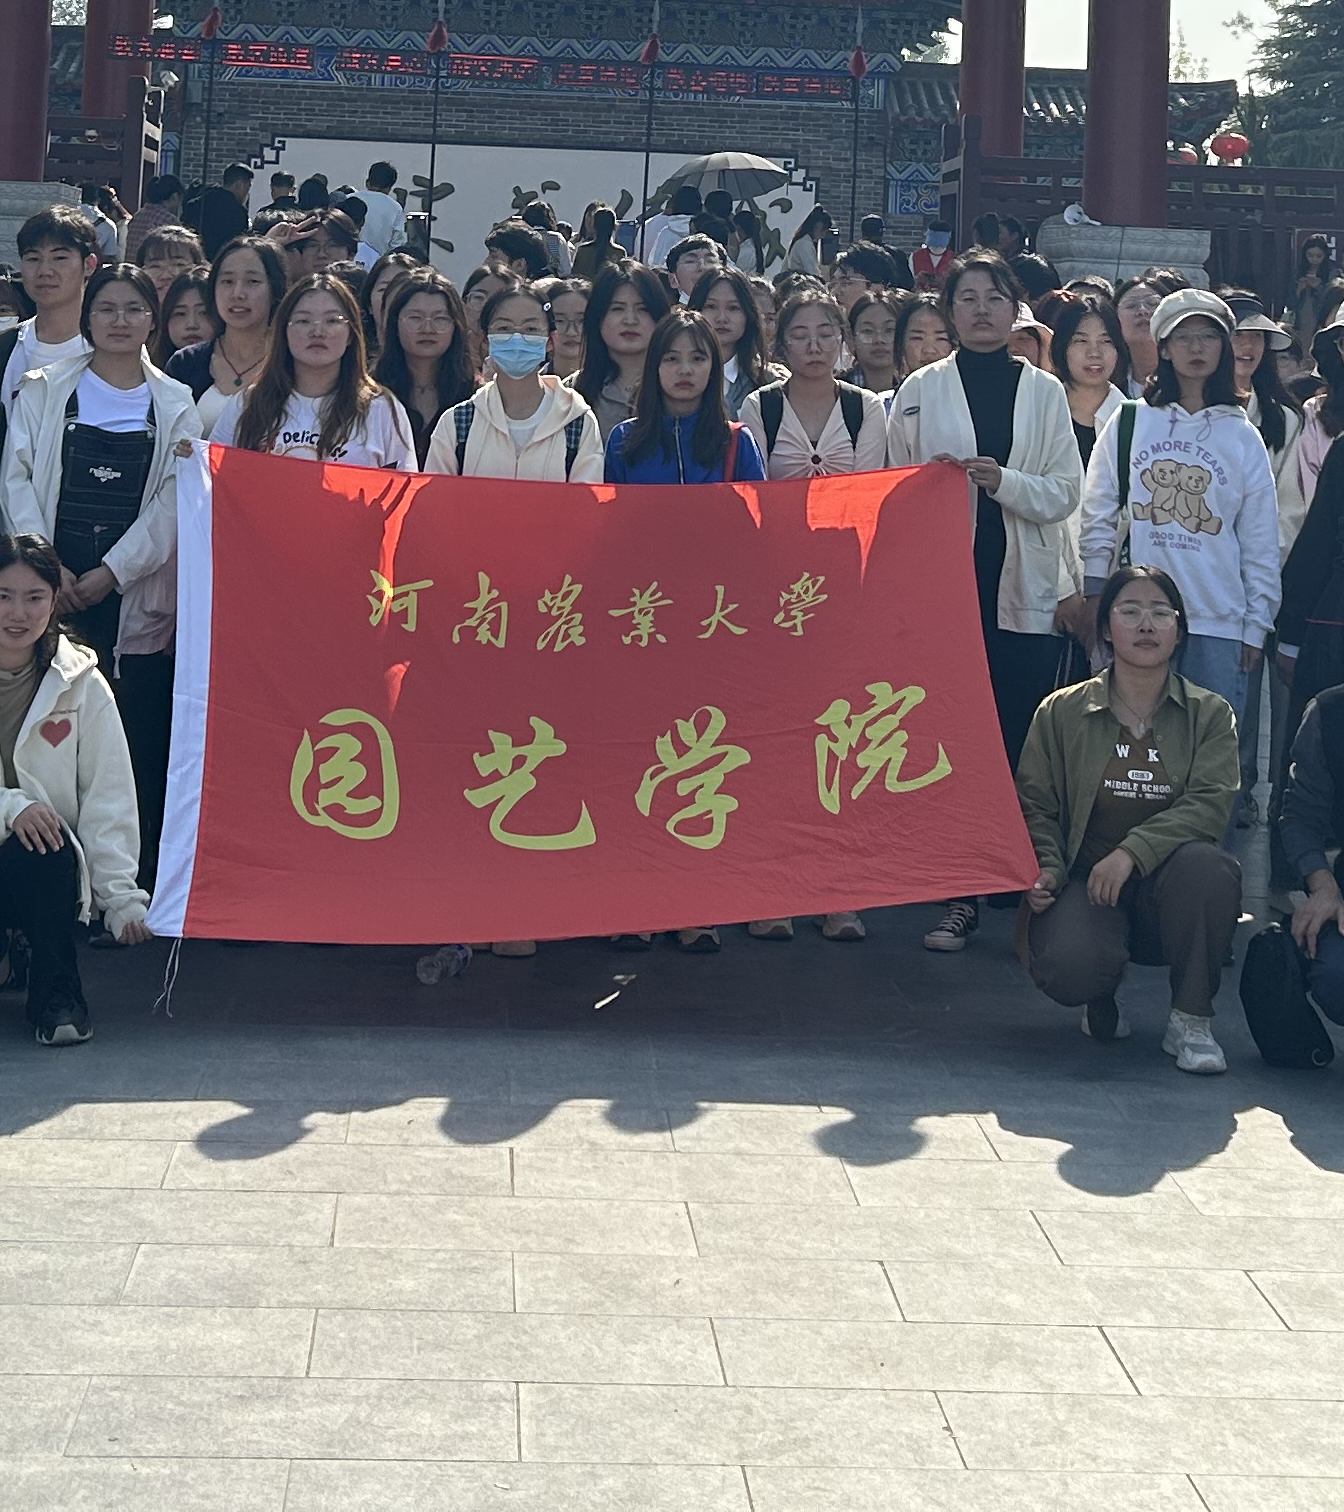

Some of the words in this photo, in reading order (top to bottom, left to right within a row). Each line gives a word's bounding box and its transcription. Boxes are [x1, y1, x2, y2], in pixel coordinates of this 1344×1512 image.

[1132, 450, 1150, 470] NO
[1151, 440, 1192, 454] MORE
[1195, 446, 1228, 487] TEARS
[1148, 531, 1174, 540] GOOD
[289, 681, 952, 850] 园艺学院
[1103, 779, 1139, 791] MIDDLE
[1141, 783, 1173, 793] SCHOO
